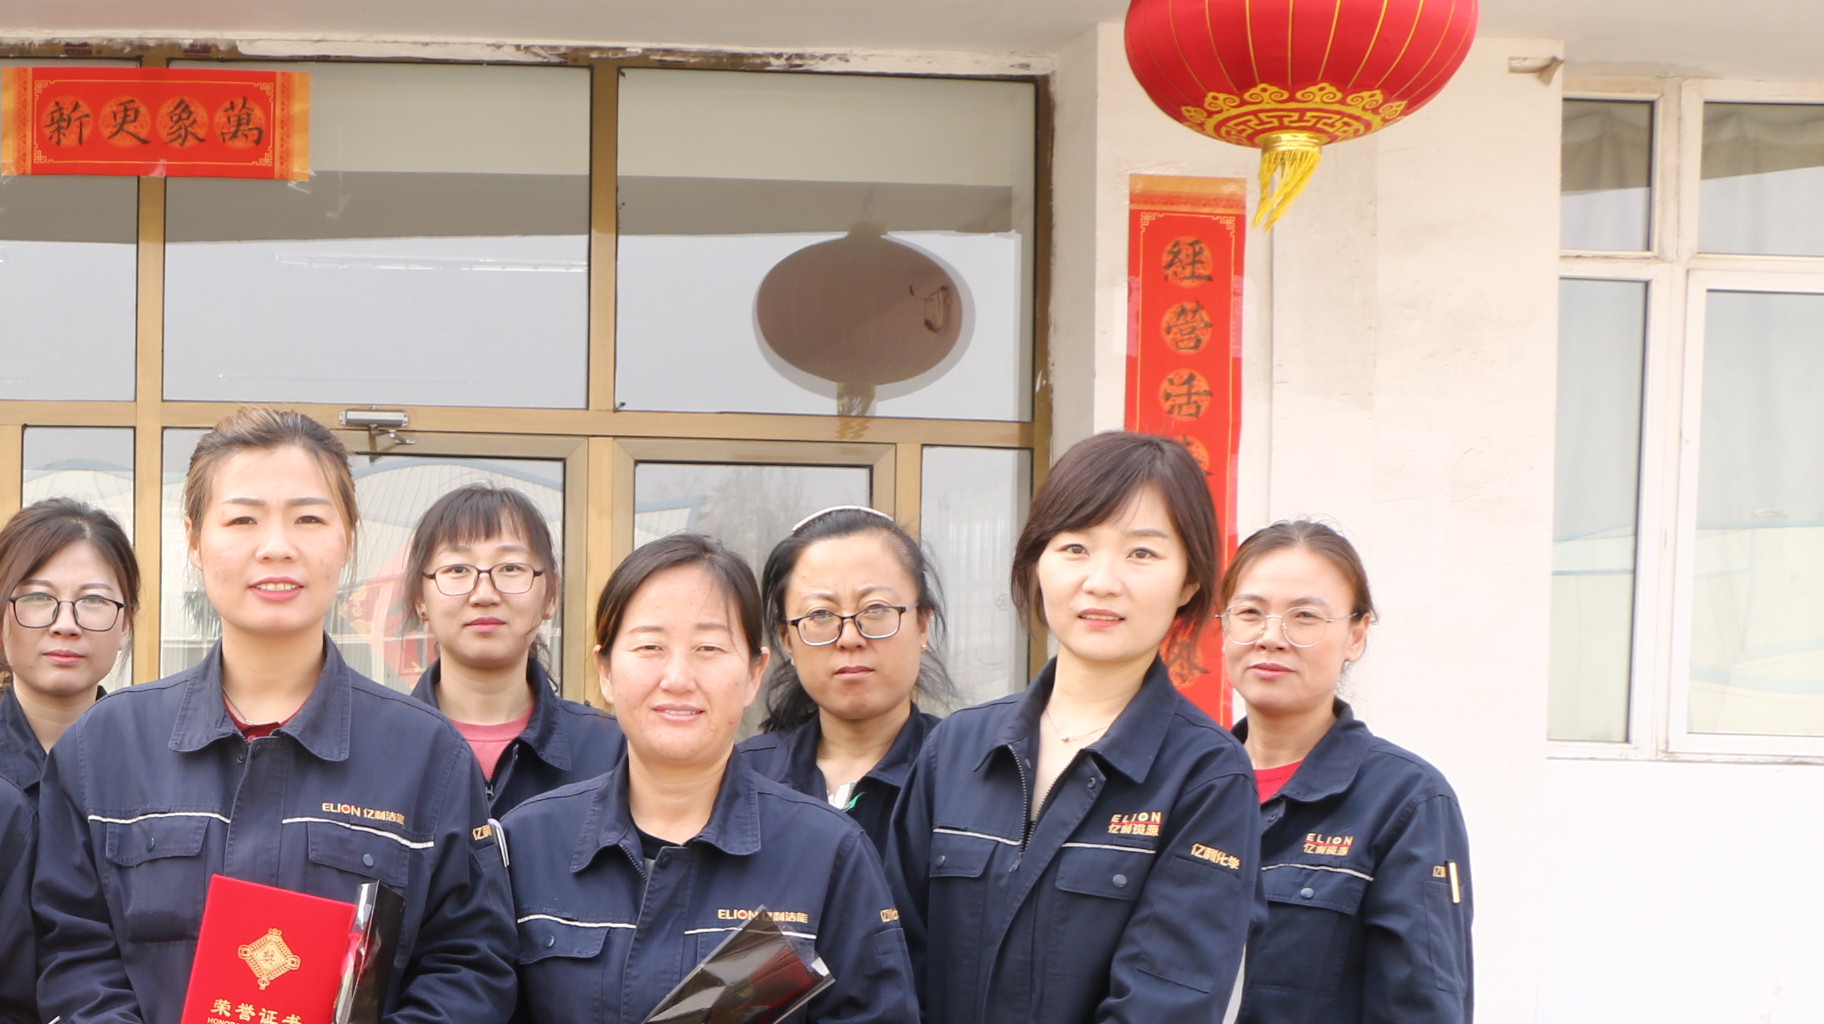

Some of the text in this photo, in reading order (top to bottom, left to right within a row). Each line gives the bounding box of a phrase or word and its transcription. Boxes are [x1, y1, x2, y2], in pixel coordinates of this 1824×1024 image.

[321, 802, 361, 817] ELION
[1110, 811, 1162, 823] ELION
[1306, 833, 1354, 845] ELION
[717, 908, 760, 920] ELION
